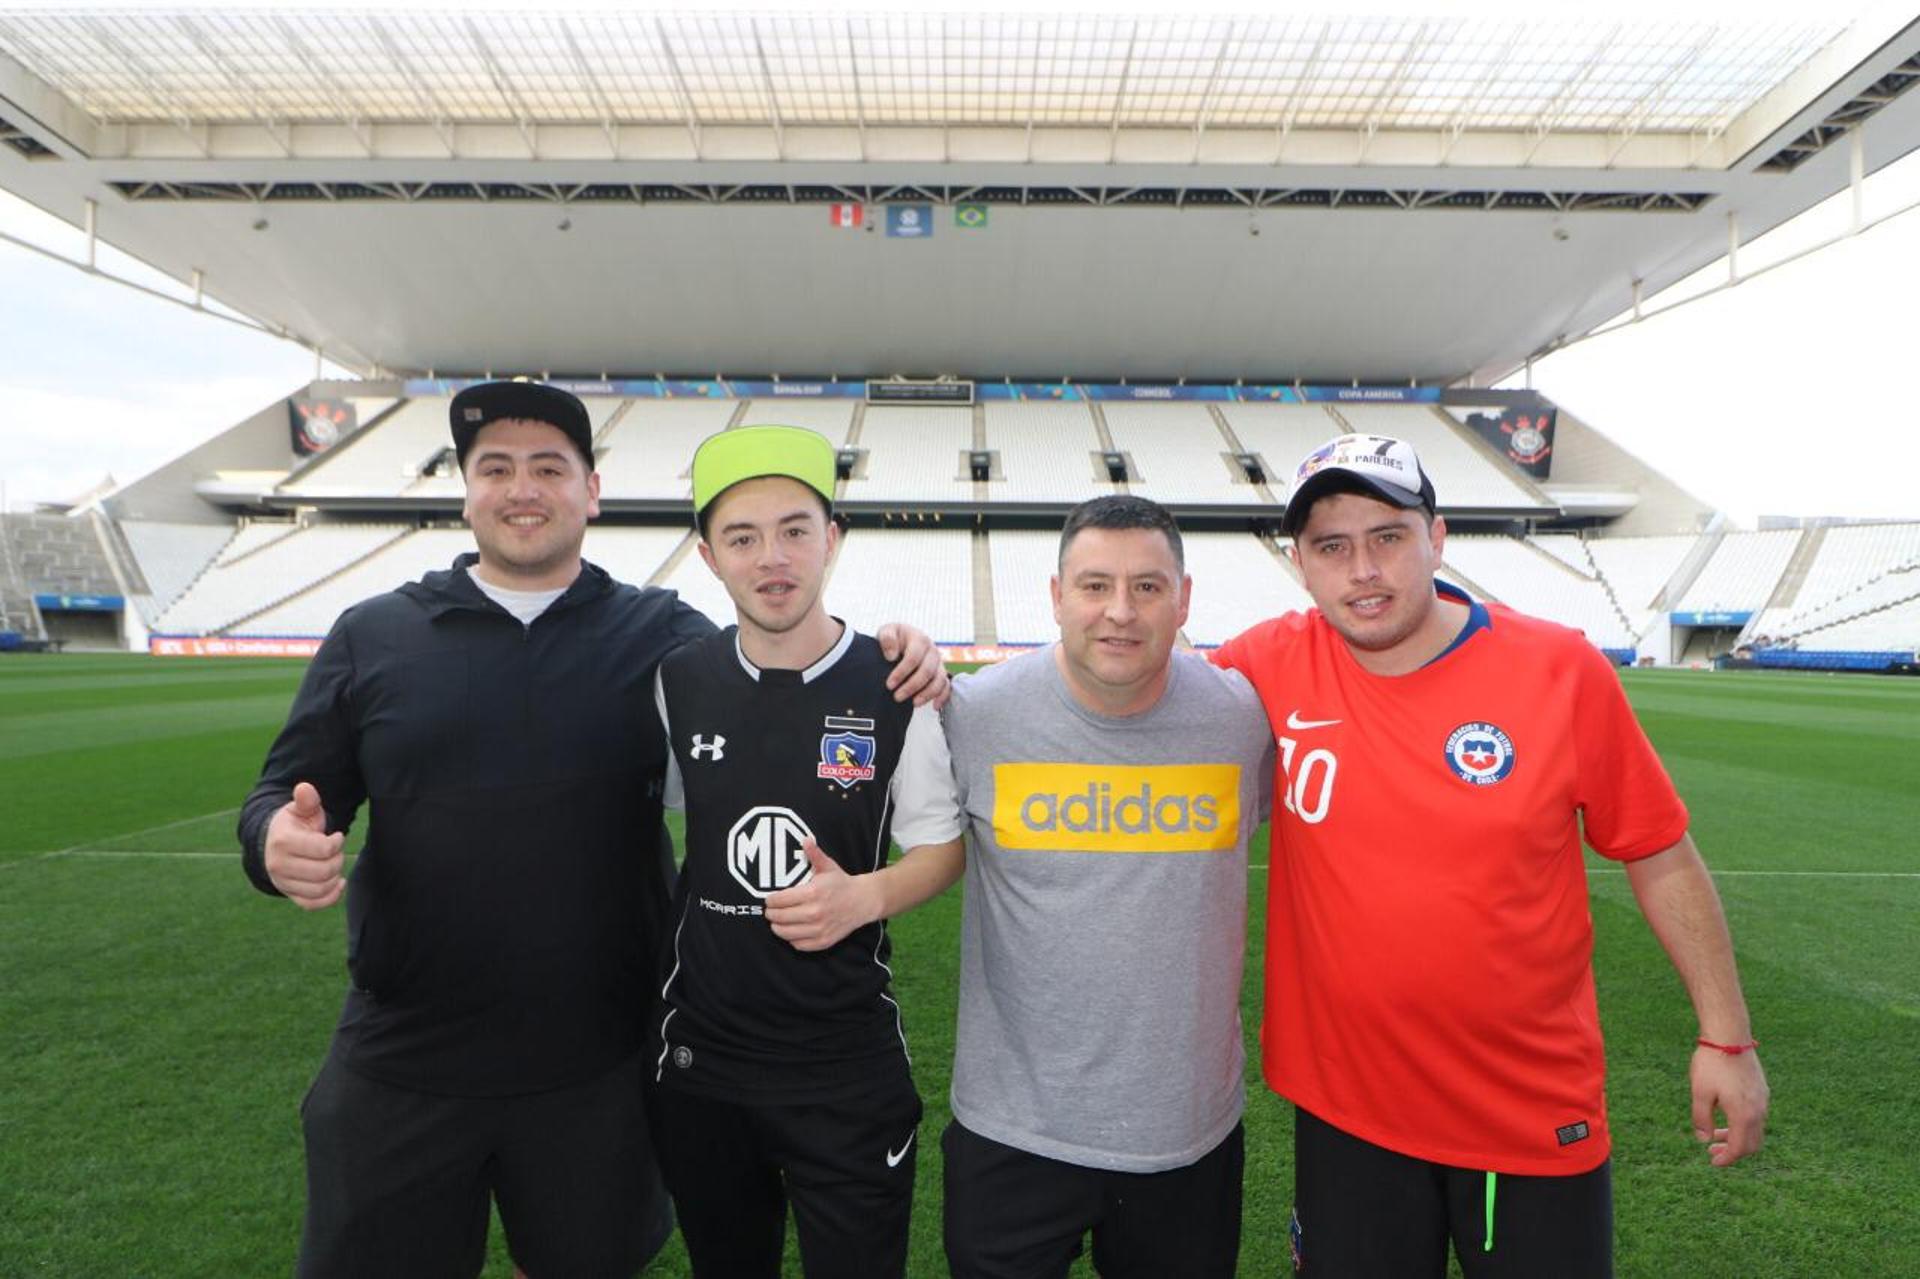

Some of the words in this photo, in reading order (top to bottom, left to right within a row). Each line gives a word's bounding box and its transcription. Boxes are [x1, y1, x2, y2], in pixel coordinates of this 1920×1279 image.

[1339, 389, 1361, 399] COPA
[1363, 389, 1403, 400] AMERICA
[1368, 437, 1397, 456] 7
[1355, 455, 1403, 471] PAREDES
[821, 766, 871, 777] COLO-COLO
[1279, 736, 1337, 823] 10
[1020, 782, 1219, 834] adidas
[737, 816, 809, 888] MG
[700, 898, 763, 916] MORRIS
